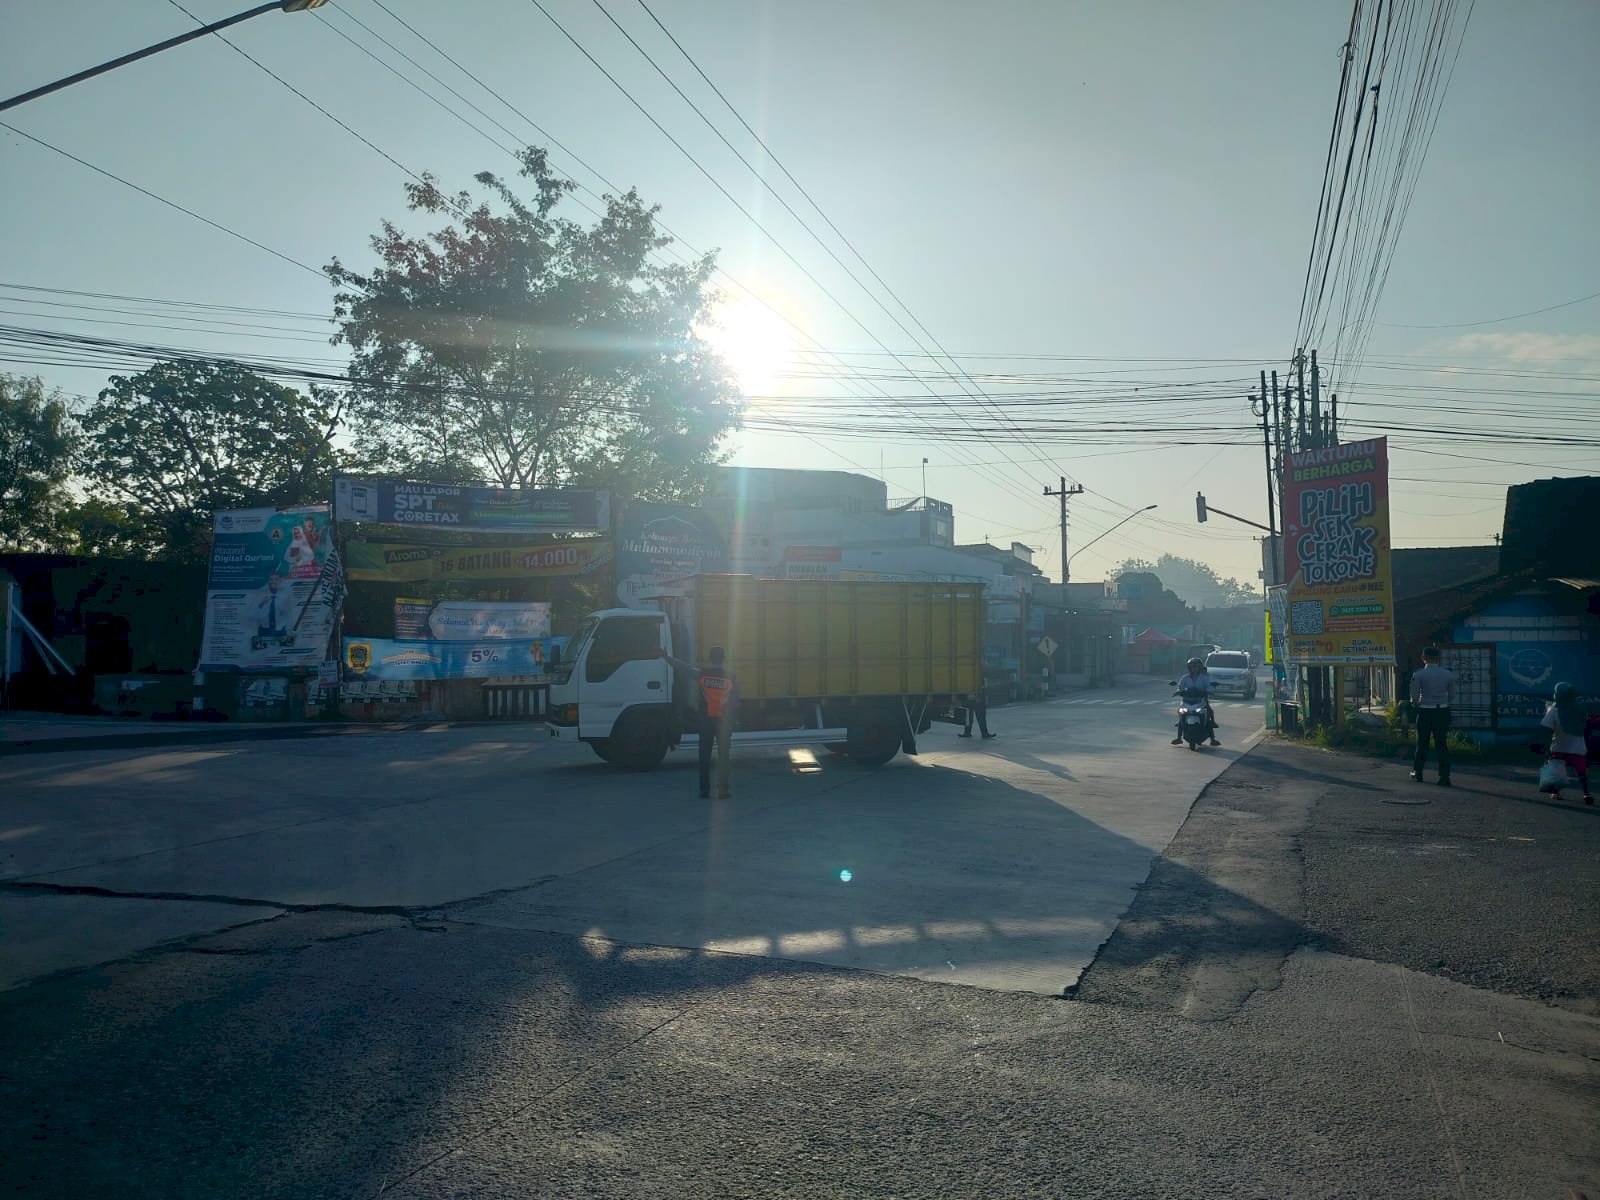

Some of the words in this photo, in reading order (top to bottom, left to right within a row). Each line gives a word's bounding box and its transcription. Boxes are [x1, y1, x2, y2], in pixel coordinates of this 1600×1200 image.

[1293, 458, 1373, 481] BERHARGA
[394, 485, 421, 494] MAU
[424, 487, 460, 496] LAPOR
[394, 494, 437, 510] SPT
[393, 510, 460, 522] CORETAX
[1313, 515, 1352, 541] SEK
[1297, 527, 1374, 563] CERAK
[213, 553, 243, 564] Digital
[389, 550, 427, 562] Aroma
[440, 559, 454, 573] 16
[458, 551, 513, 571] BATANG
[524, 547, 578, 569] 14.000
[1300, 554, 1373, 585] TOKONE
[471, 649, 499, 663] 5%
